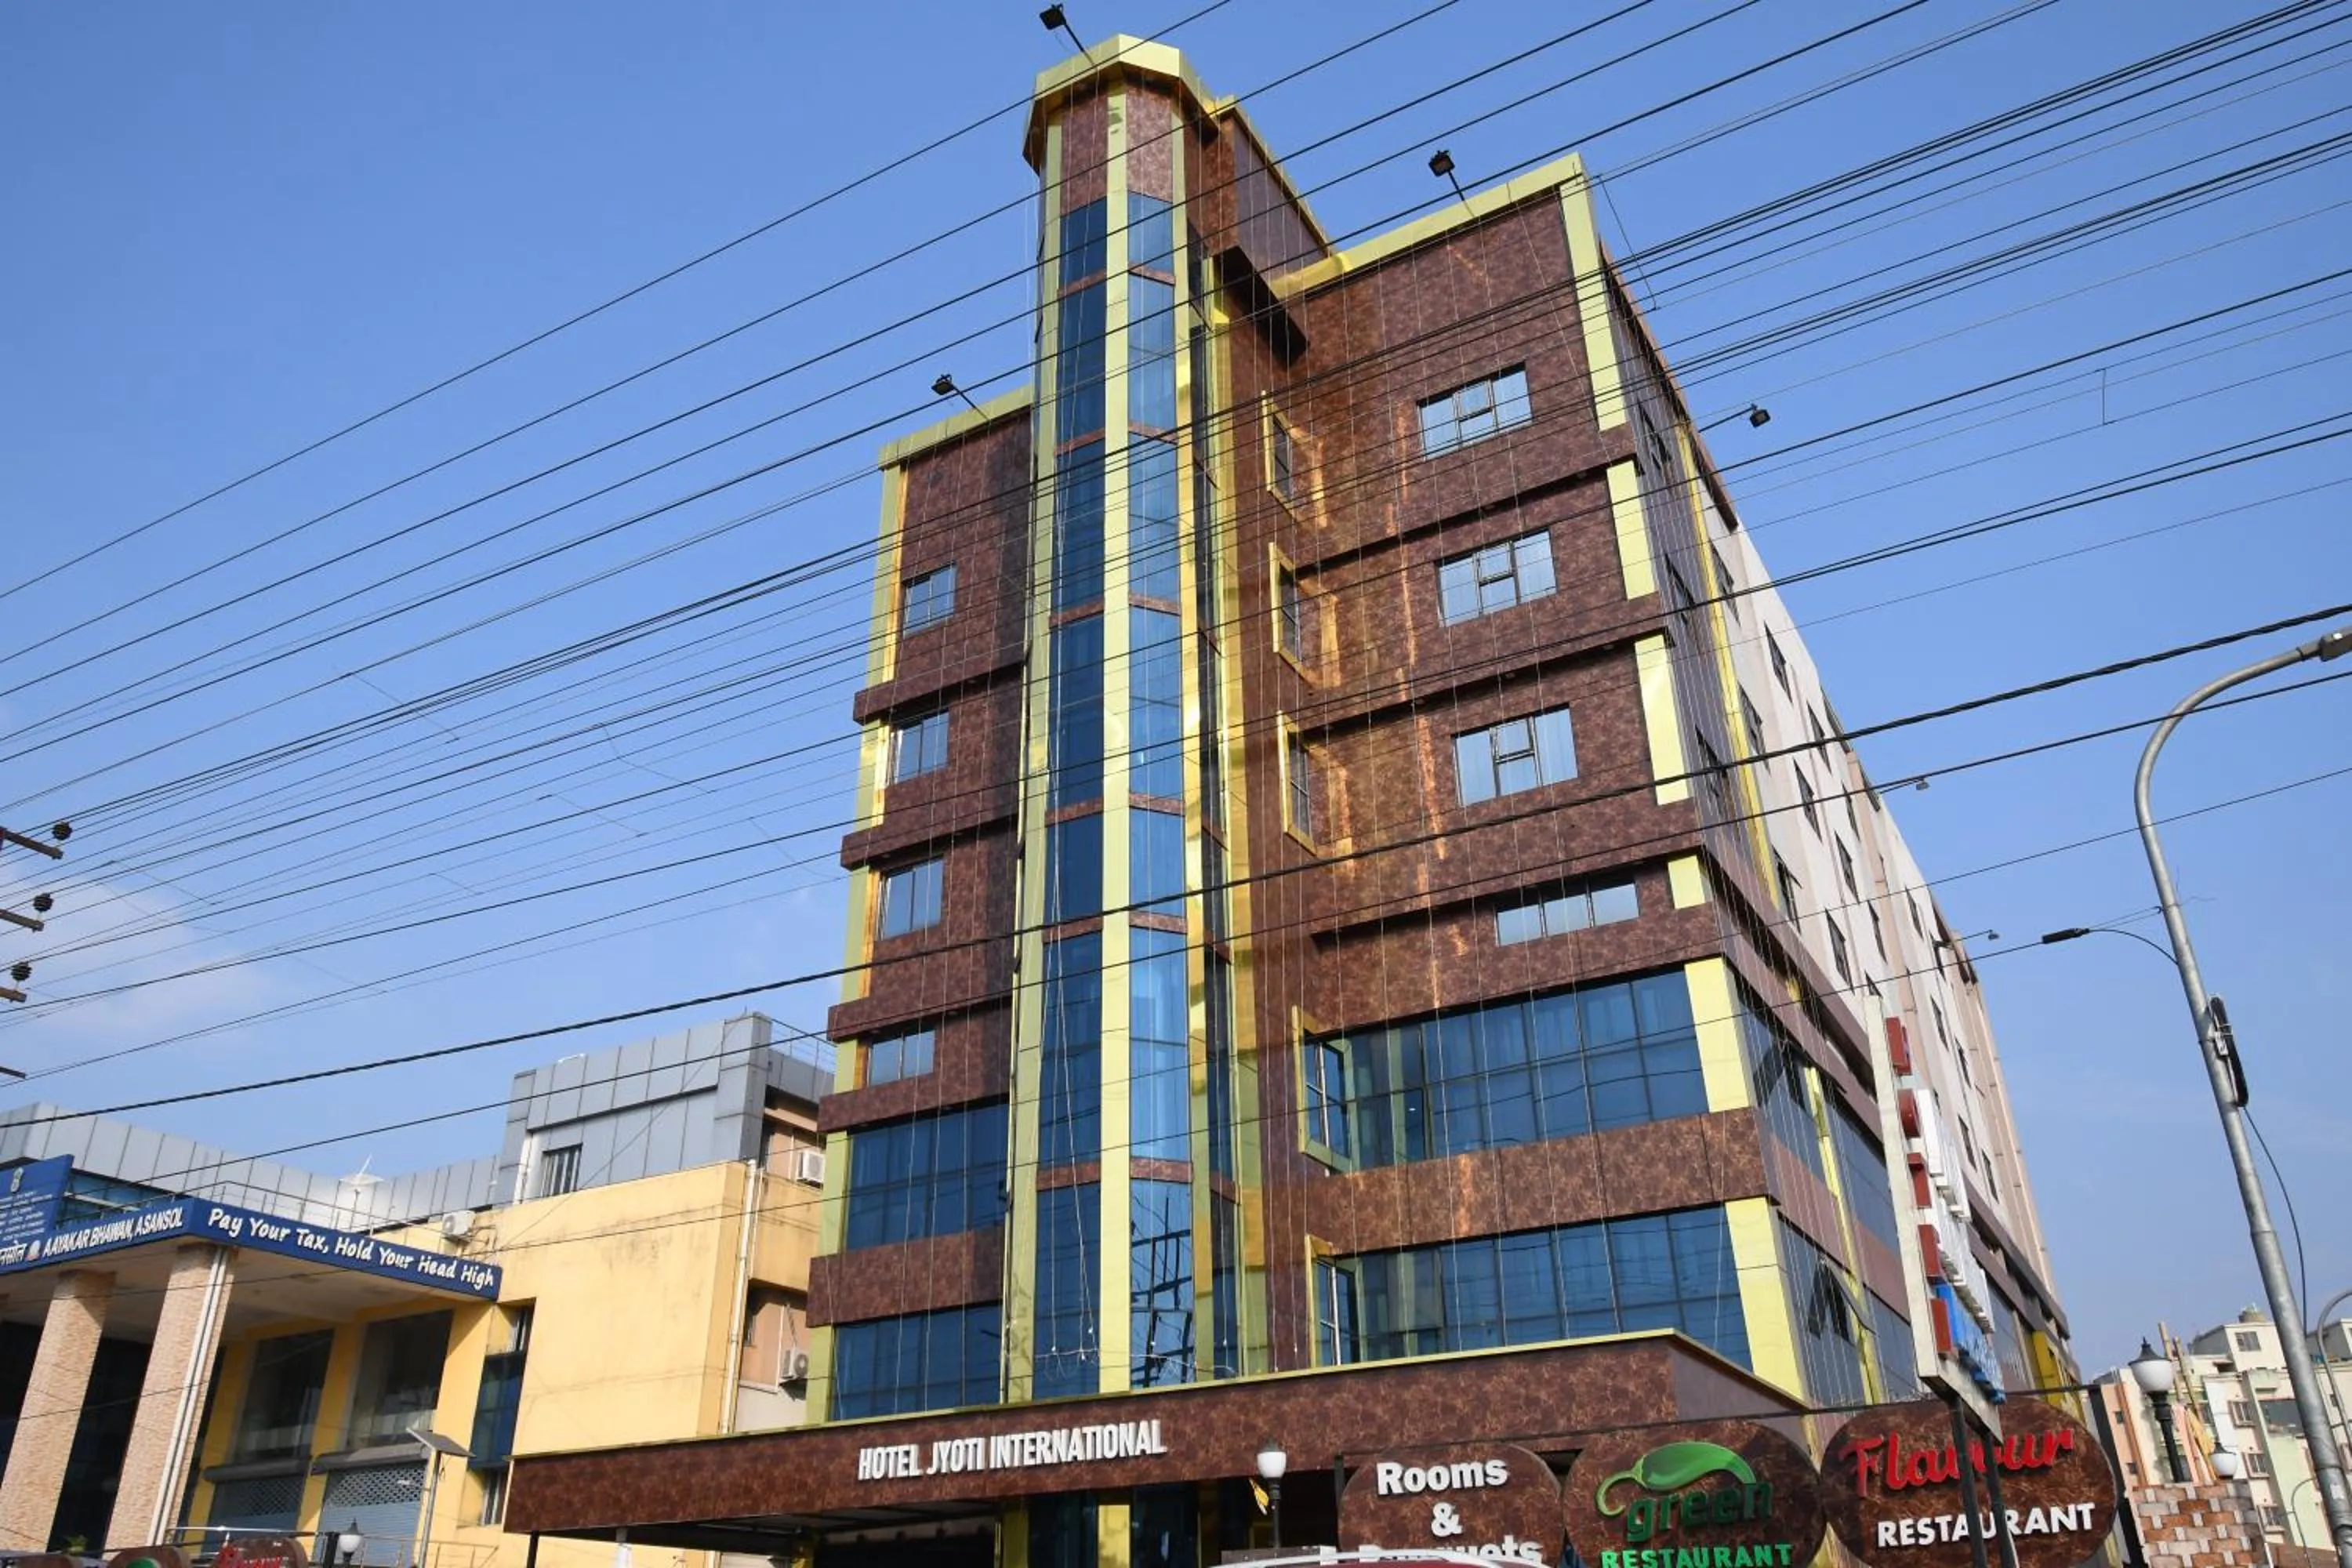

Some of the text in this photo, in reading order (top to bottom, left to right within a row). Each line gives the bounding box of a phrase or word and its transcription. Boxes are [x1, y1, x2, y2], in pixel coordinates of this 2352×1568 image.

[42, 1228, 92, 1258] AAYAKAR
[134, 1207, 183, 1238] ASANSOL
[208, 1208, 494, 1290] Pay Your Tax, Hold Your Head High
[858, 1419, 1167, 1480] HOTEL JYOTI INTERNATIONAL
[1376, 1459, 1509, 1495] Rooms
[1431, 1502, 1463, 1537] &
[1626, 1481, 1773, 1543] green
[1601, 1544, 1793, 1568] RESTAURANT
